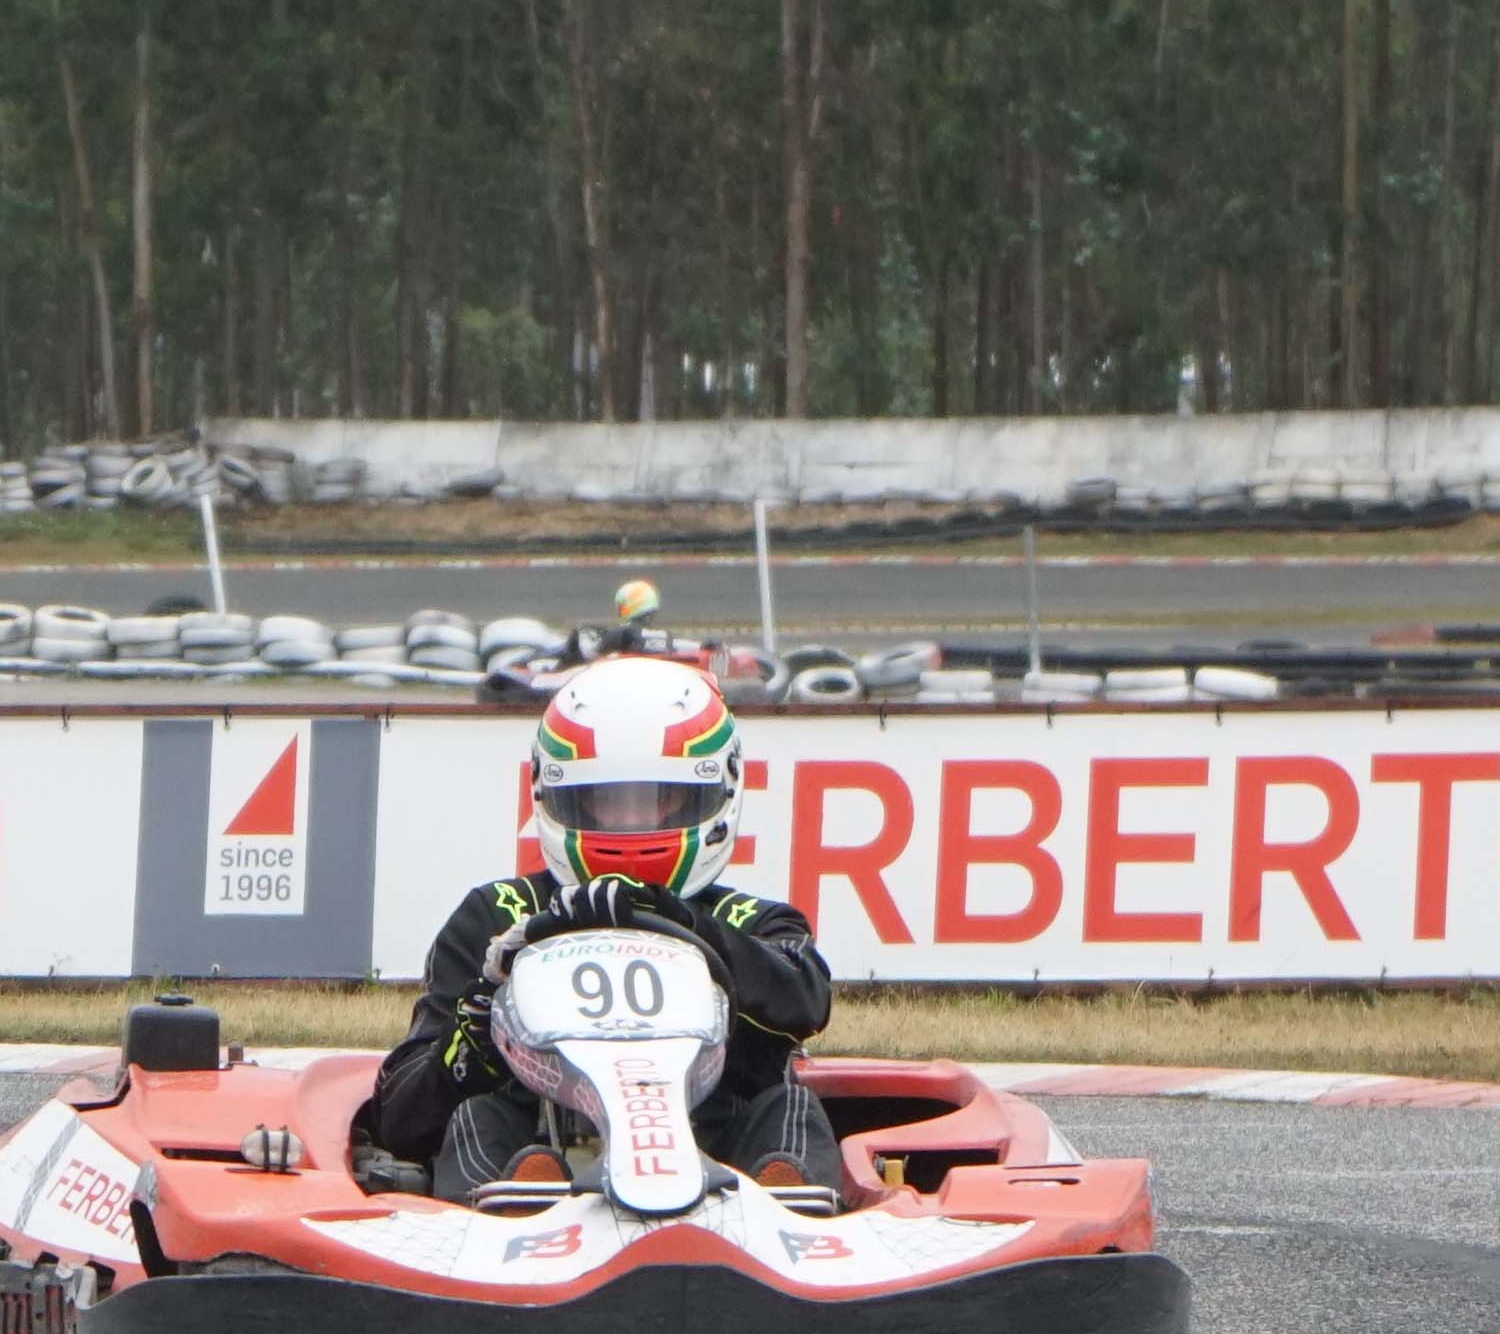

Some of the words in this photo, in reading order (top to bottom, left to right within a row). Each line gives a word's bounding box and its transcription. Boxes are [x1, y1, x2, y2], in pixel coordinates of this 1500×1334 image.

[220, 840, 294, 868] since
[219, 874, 292, 902] 1996
[541, 942, 681, 964] EUROINDY
[571, 959, 665, 1019] 90
[613, 1058, 679, 1178] FERBERTO
